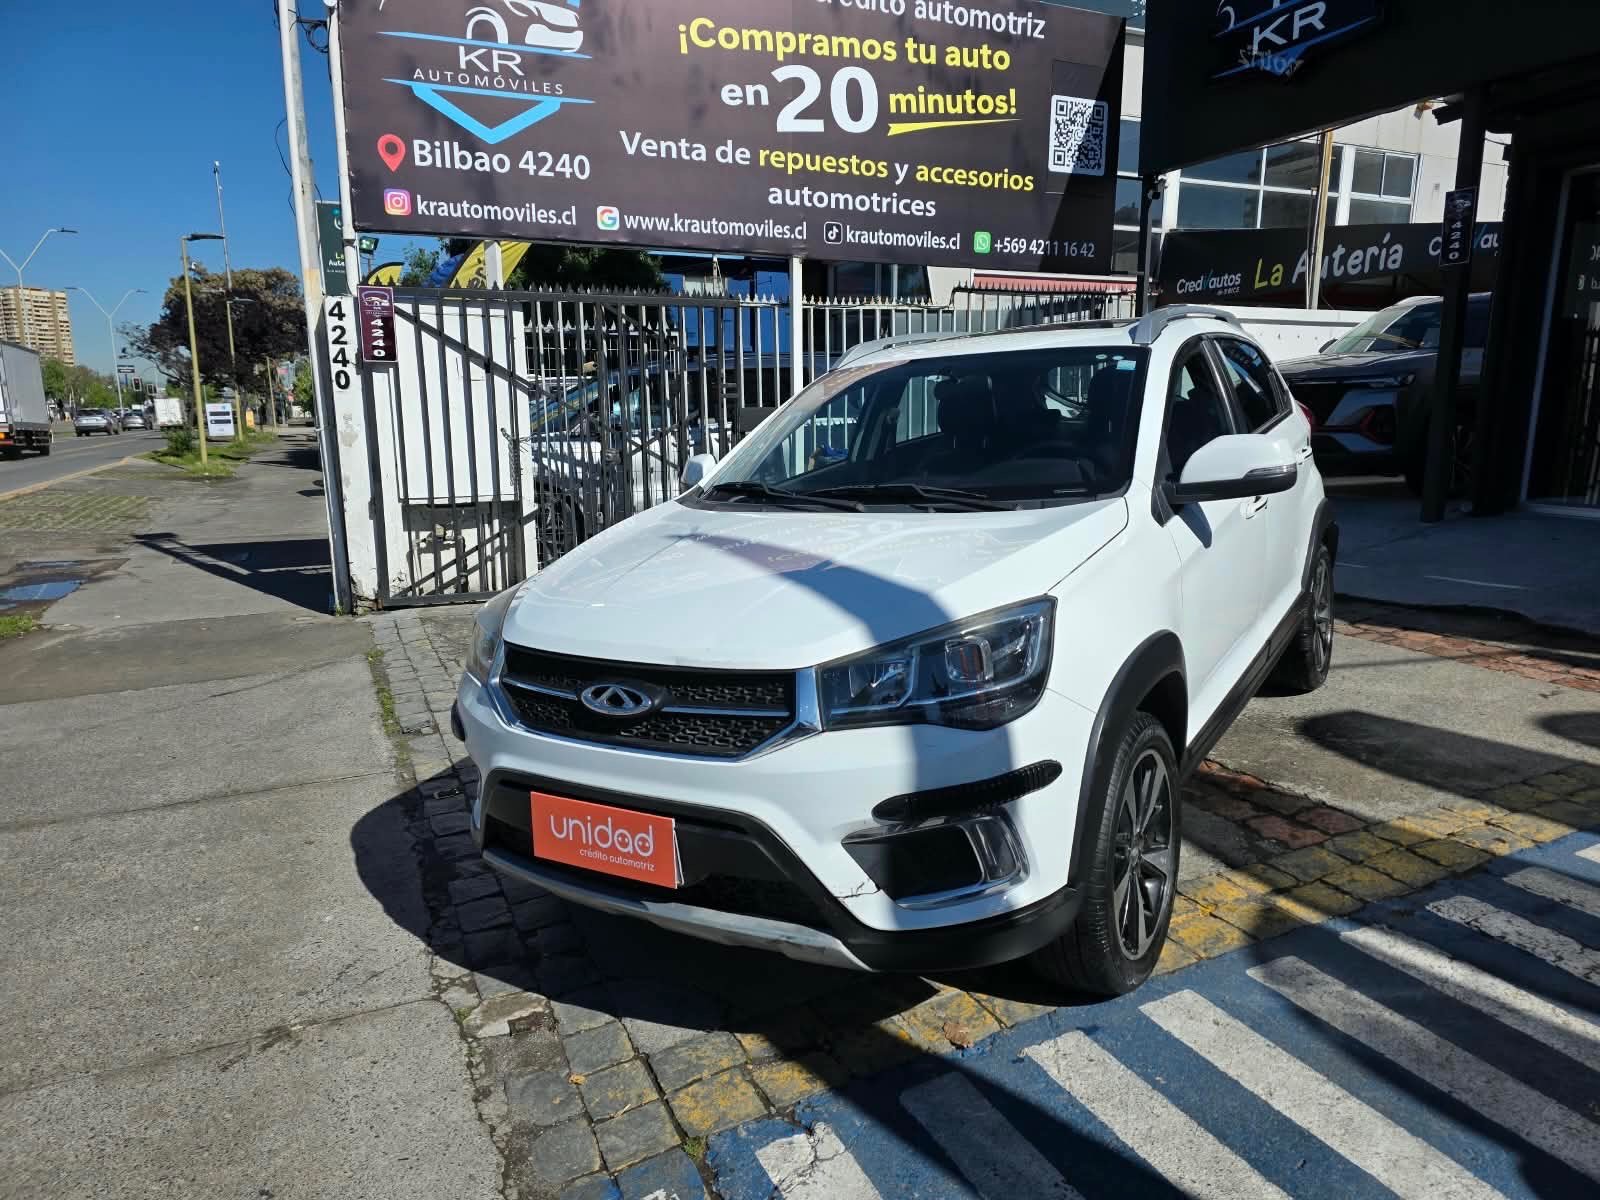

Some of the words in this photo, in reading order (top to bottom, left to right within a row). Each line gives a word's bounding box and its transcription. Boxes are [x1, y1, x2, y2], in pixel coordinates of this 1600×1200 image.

[914, 0, 1046, 39] automotriz
[1252, 1, 1327, 56] KR
[459, 45, 525, 76] KR
[678, 17, 897, 62] ¡Compramos
[905, 37, 937, 65] tu
[945, 44, 1011, 71] auto
[413, 68, 564, 95] AUTOMÓVILES
[720, 83, 770, 106] en
[770, 64, 879, 134] 20
[889, 85, 1017, 115] minutos!
[413, 139, 511, 173] Bilbao
[519, 150, 591, 180] 4240
[619, 130, 707, 162] Venta
[715, 139, 751, 165] de
[759, 148, 889, 179] repuestos
[894, 162, 909, 185] y
[915, 164, 1035, 191] accesorios
[416, 194, 577, 226] krautomoviles.cl
[768, 186, 937, 217] automotrices
[623, 212, 808, 240] www.krautomoviles.cl
[846, 225, 961, 250] krautomoviles.cl
[994, 237, 1027, 255] +569
[1029, 238, 1059, 256] 4211
[1063, 240, 1079, 257] 16
[1080, 241, 1096, 258] 42
[1254, 258, 1285, 290] La
[328, 300, 351, 390] 4240
[370, 318, 386, 357] 4240
[549, 814, 654, 857] unidad
[579, 848, 608, 862] crédito
[609, 856, 656, 873] automotriz
